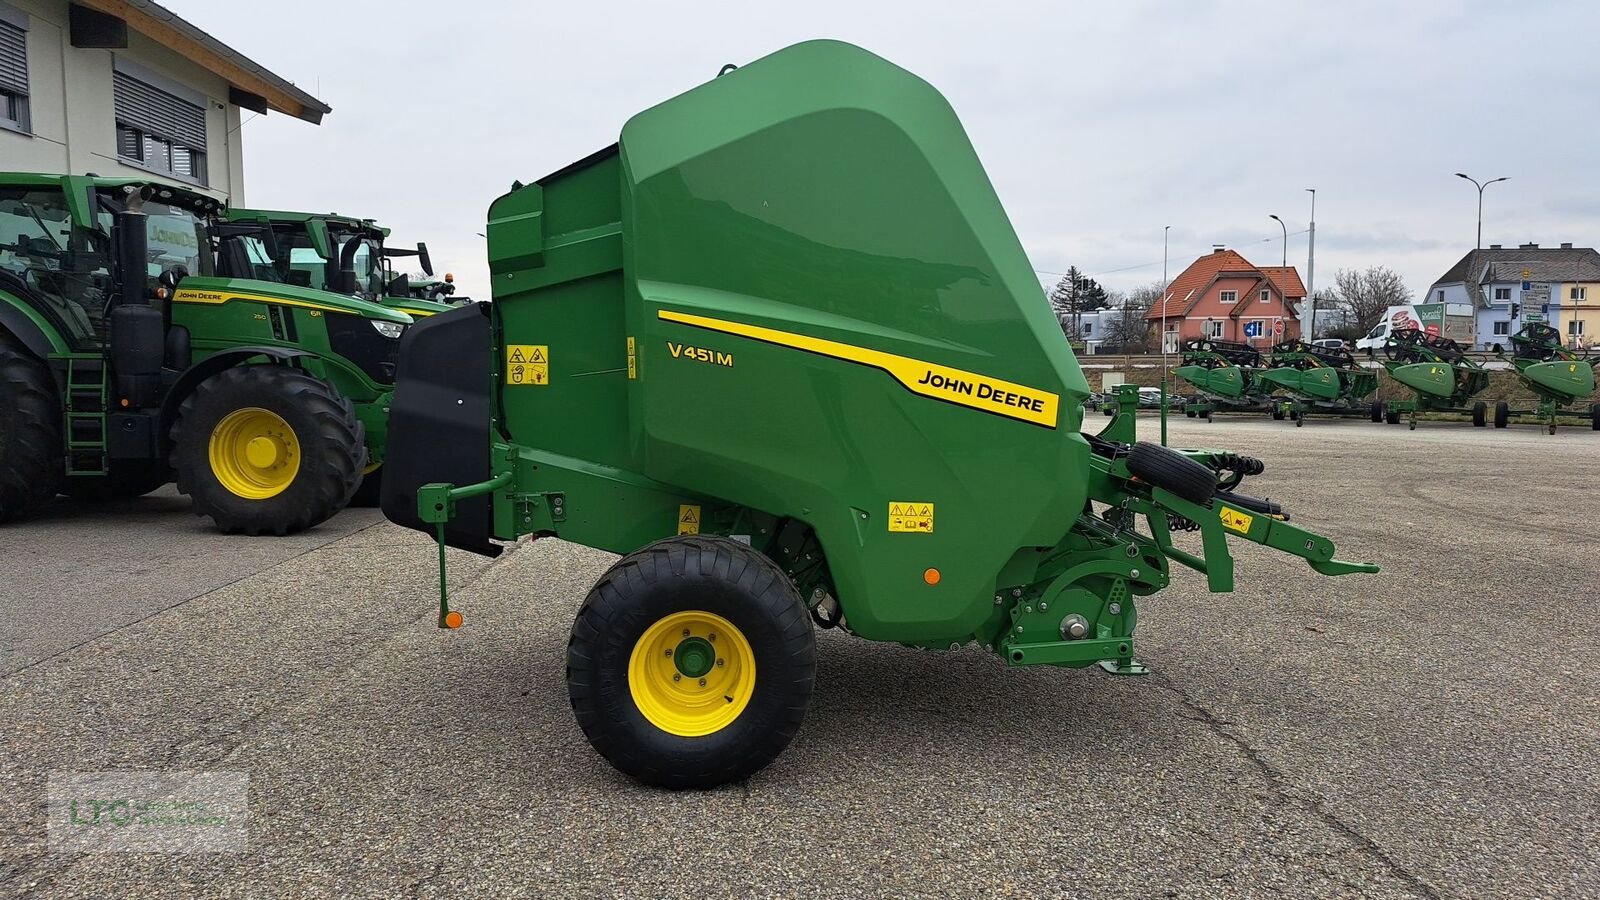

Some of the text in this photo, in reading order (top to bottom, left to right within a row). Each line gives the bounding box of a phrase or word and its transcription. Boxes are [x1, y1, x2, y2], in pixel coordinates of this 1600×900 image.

[178, 291, 222, 300] JOHN DEERE
[918, 370, 1045, 413] JOHN DEERE
